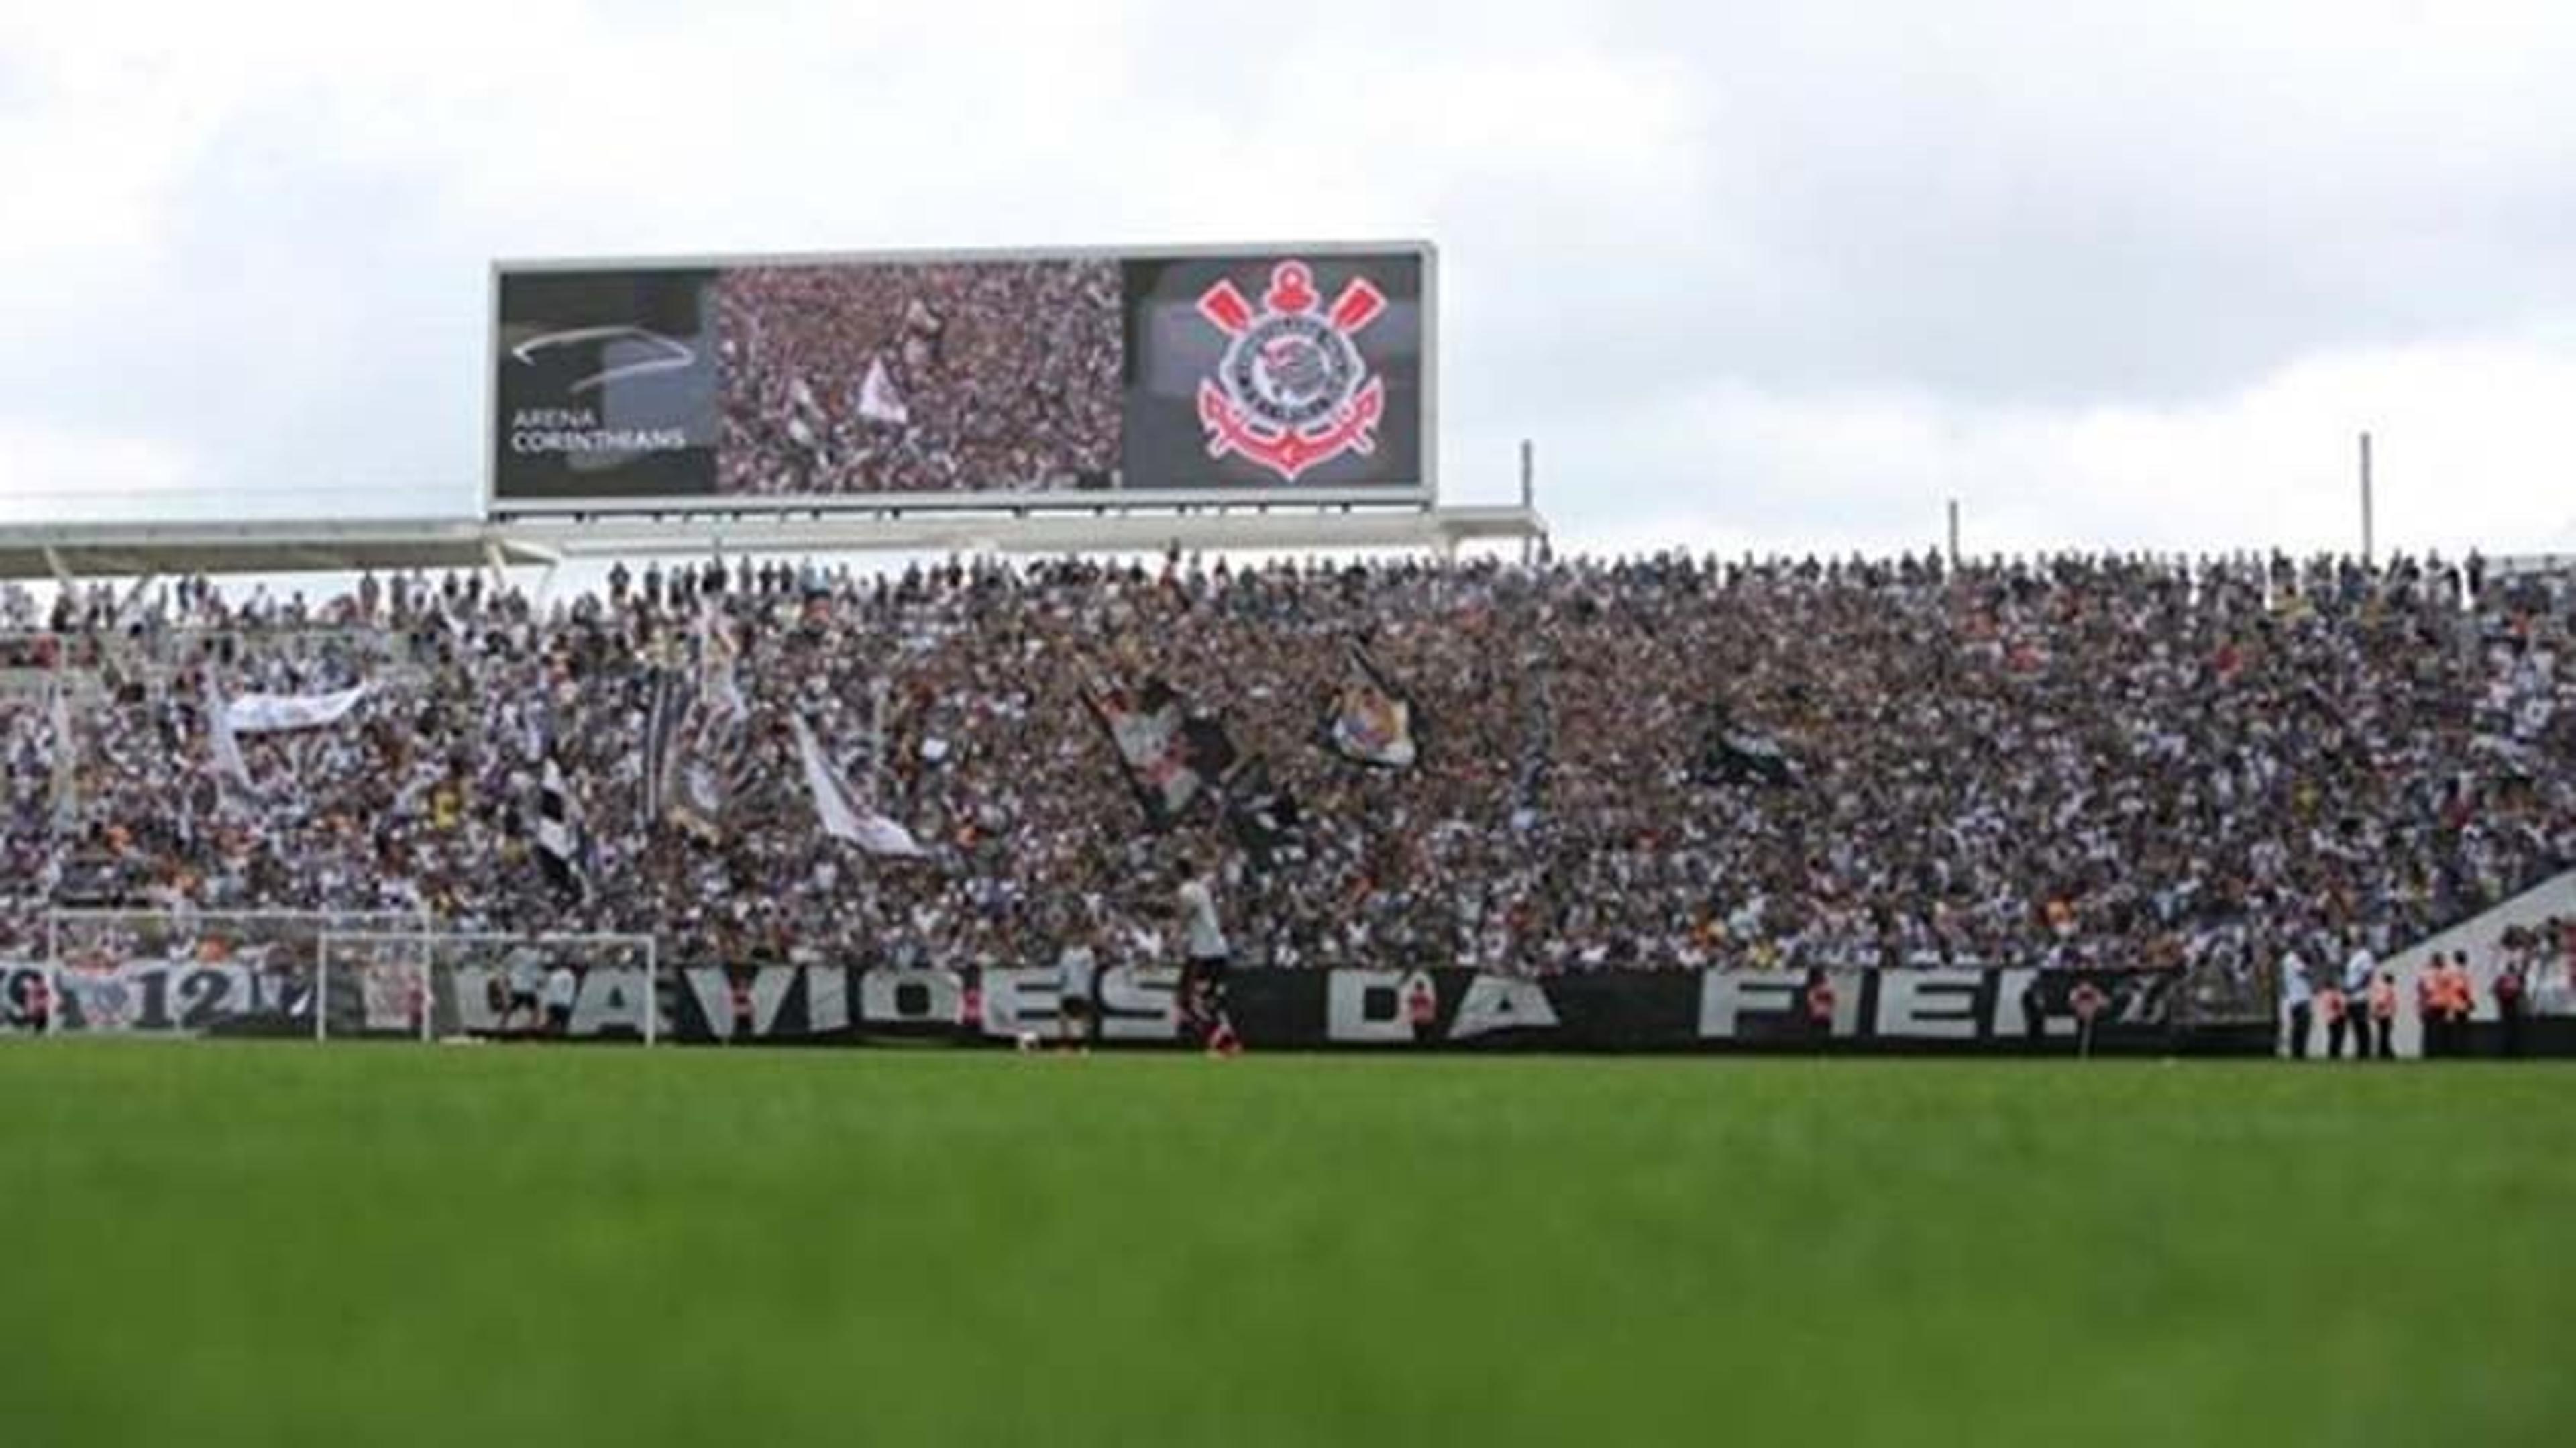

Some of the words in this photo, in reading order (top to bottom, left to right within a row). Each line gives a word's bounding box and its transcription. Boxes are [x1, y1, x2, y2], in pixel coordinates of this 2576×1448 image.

[512, 409, 596, 428] ARENA
[511, 429, 686, 452] CORINTHIANS
[1328, 970, 1561, 1039] DA
